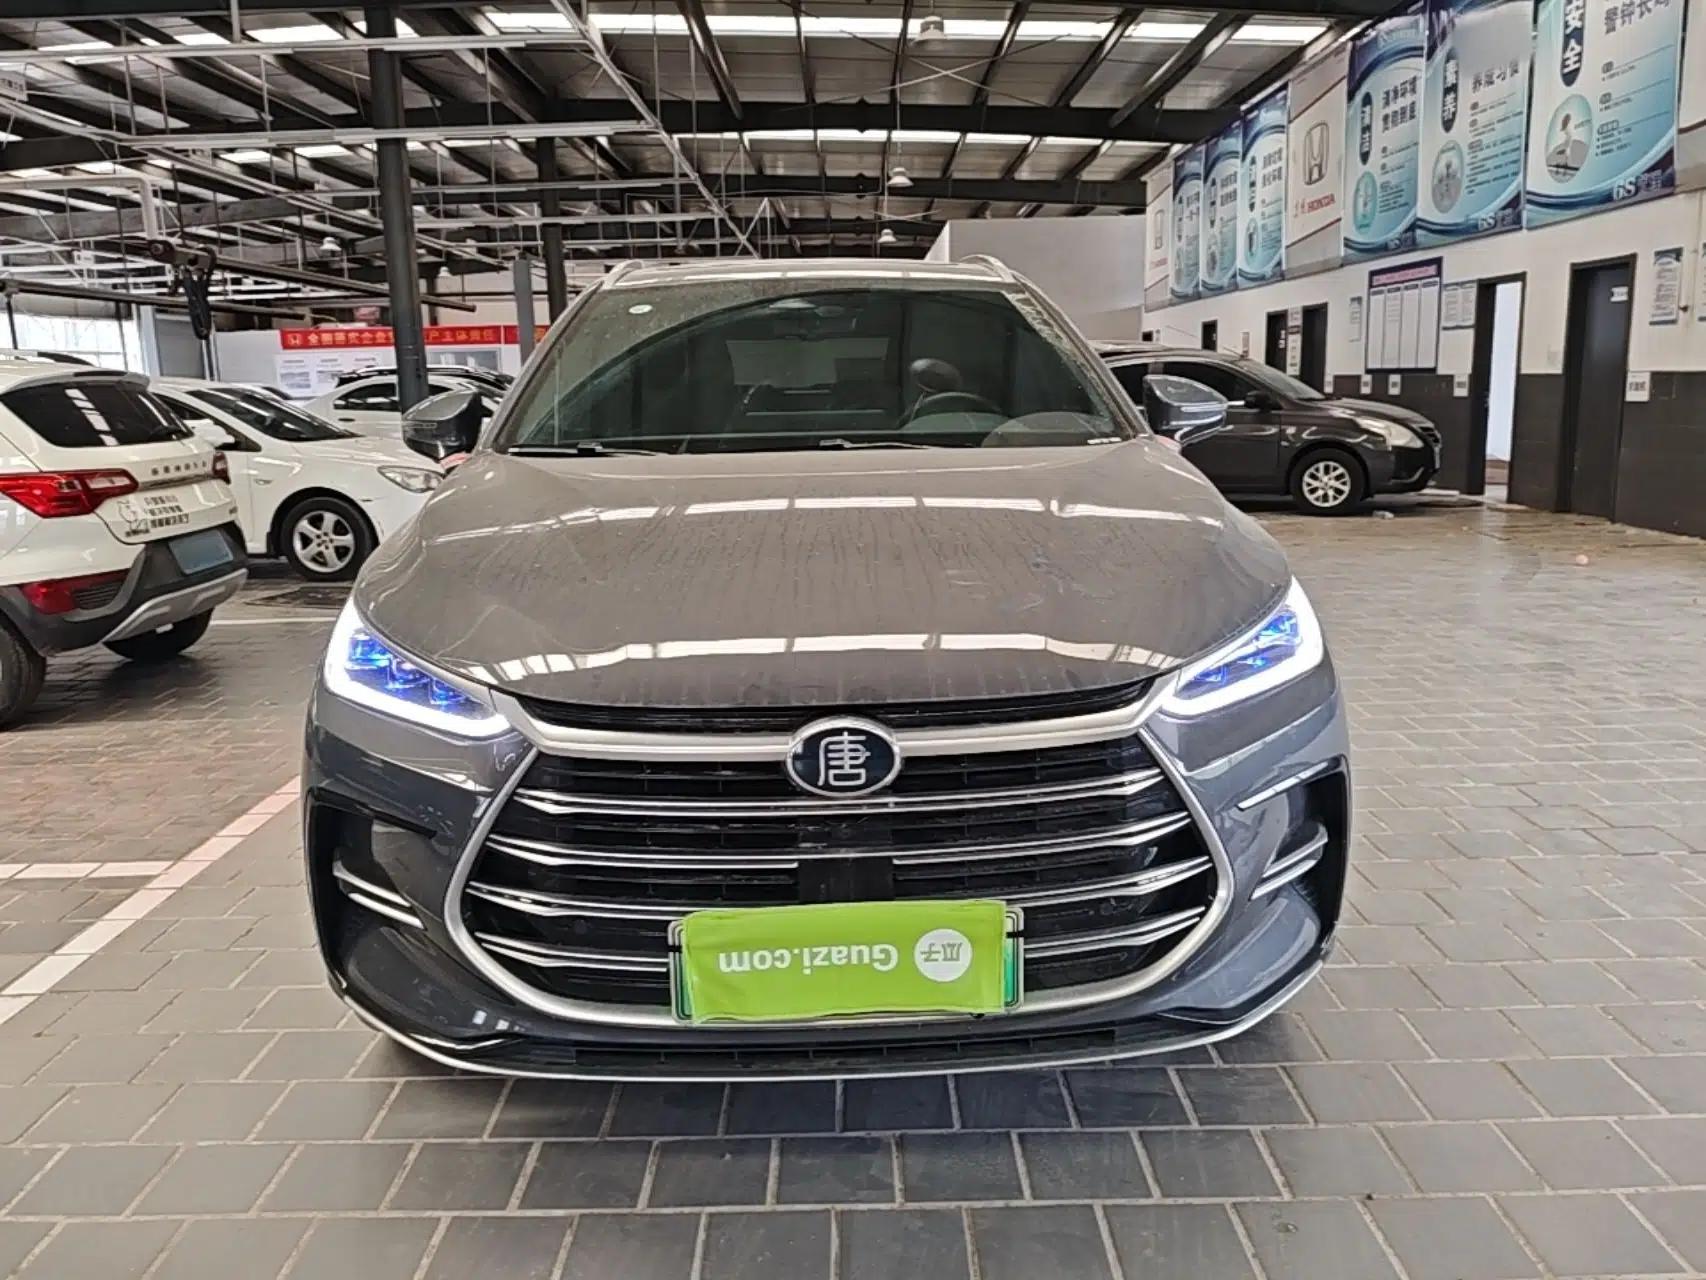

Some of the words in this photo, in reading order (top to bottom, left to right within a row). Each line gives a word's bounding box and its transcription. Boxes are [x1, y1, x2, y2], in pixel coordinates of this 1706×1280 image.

[1563, 0, 1583, 74] 安全
[817, 731, 872, 786] 唐
[718, 943, 898, 975] Guazi.com
